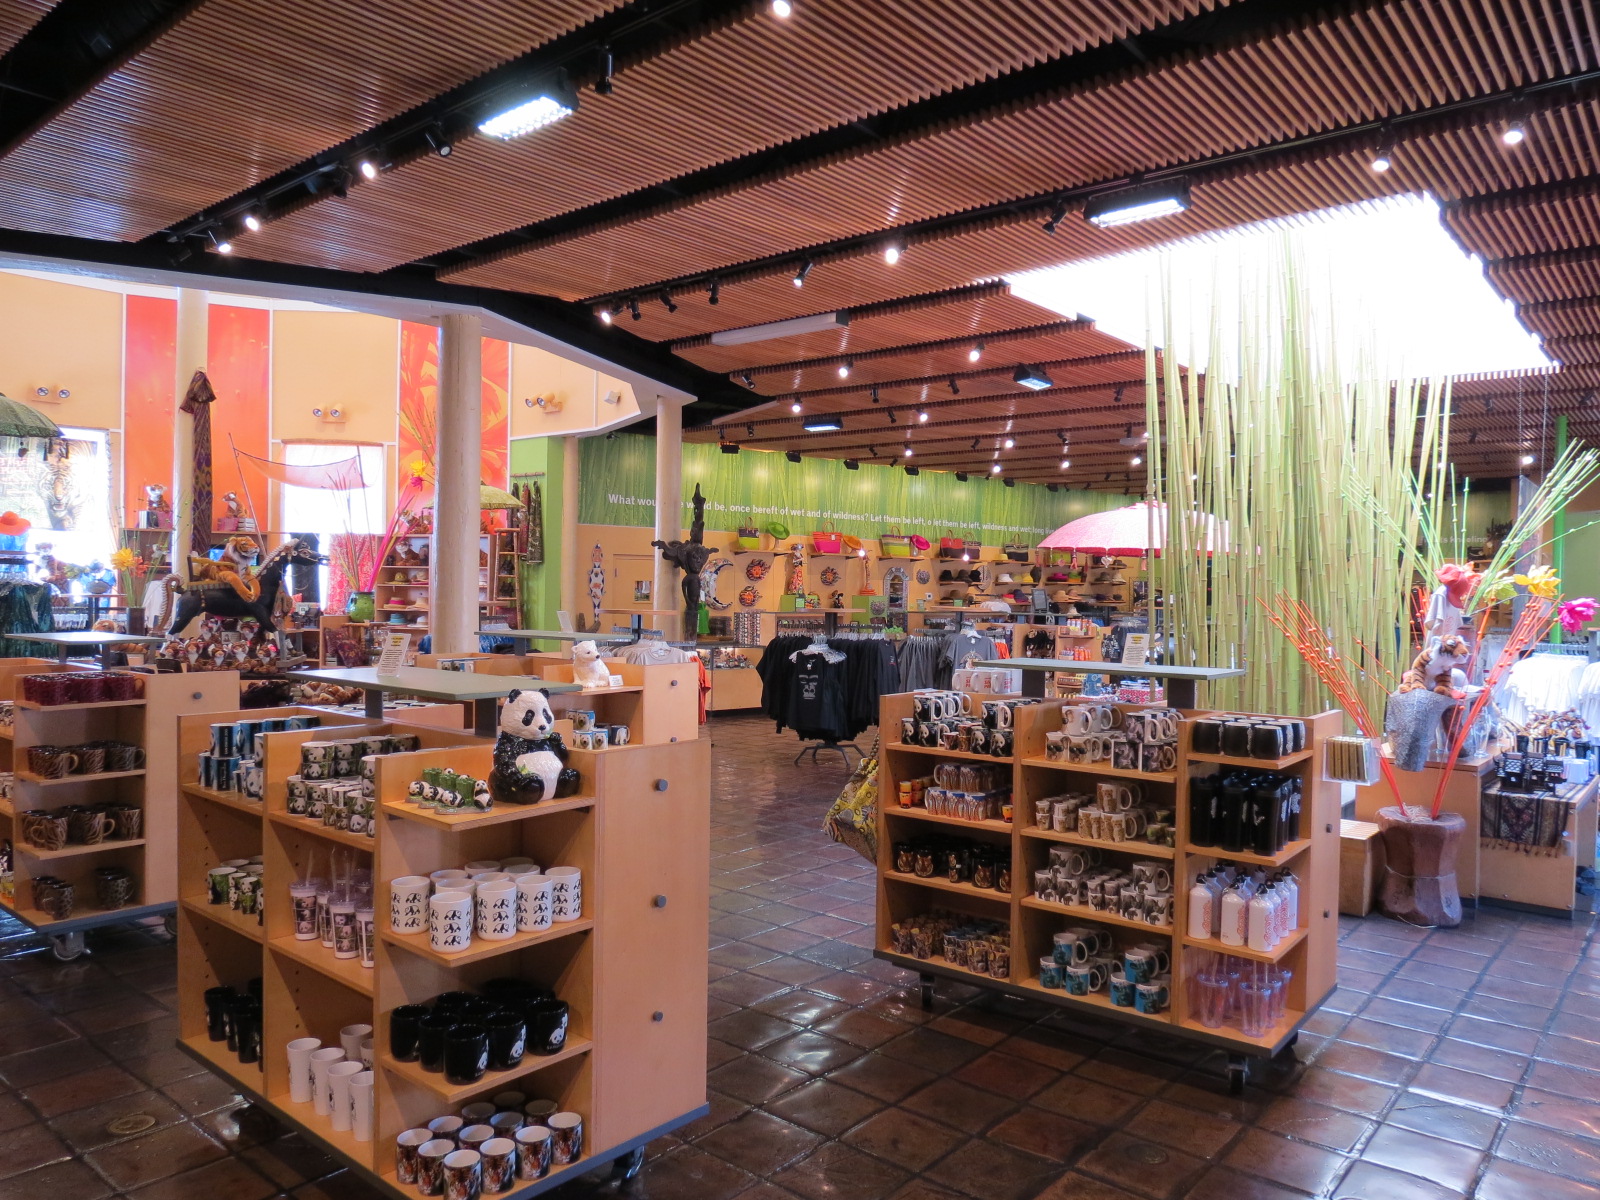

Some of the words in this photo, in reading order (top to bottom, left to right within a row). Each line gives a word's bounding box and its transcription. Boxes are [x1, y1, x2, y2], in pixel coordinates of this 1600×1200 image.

[608, 493, 636, 505] What
[637, 498, 656, 507] wou
[687, 501, 712, 510] wld
[714, 501, 728, 512] be,
[729, 504, 751, 513] once
[752, 504, 778, 515] bereft
[779, 506, 788, 516] of
[790, 508, 805, 517] wet
[806, 509, 820, 518] and
[823, 510, 831, 519] of
[833, 511, 869, 522] wildness?
[870, 514, 882, 523] Let
[883, 515, 901, 524] them
[903, 516, 911, 525] be
[942, 519, 959, 528] them
[960, 521, 968, 529] be
[982, 523, 1008, 532] wildness
